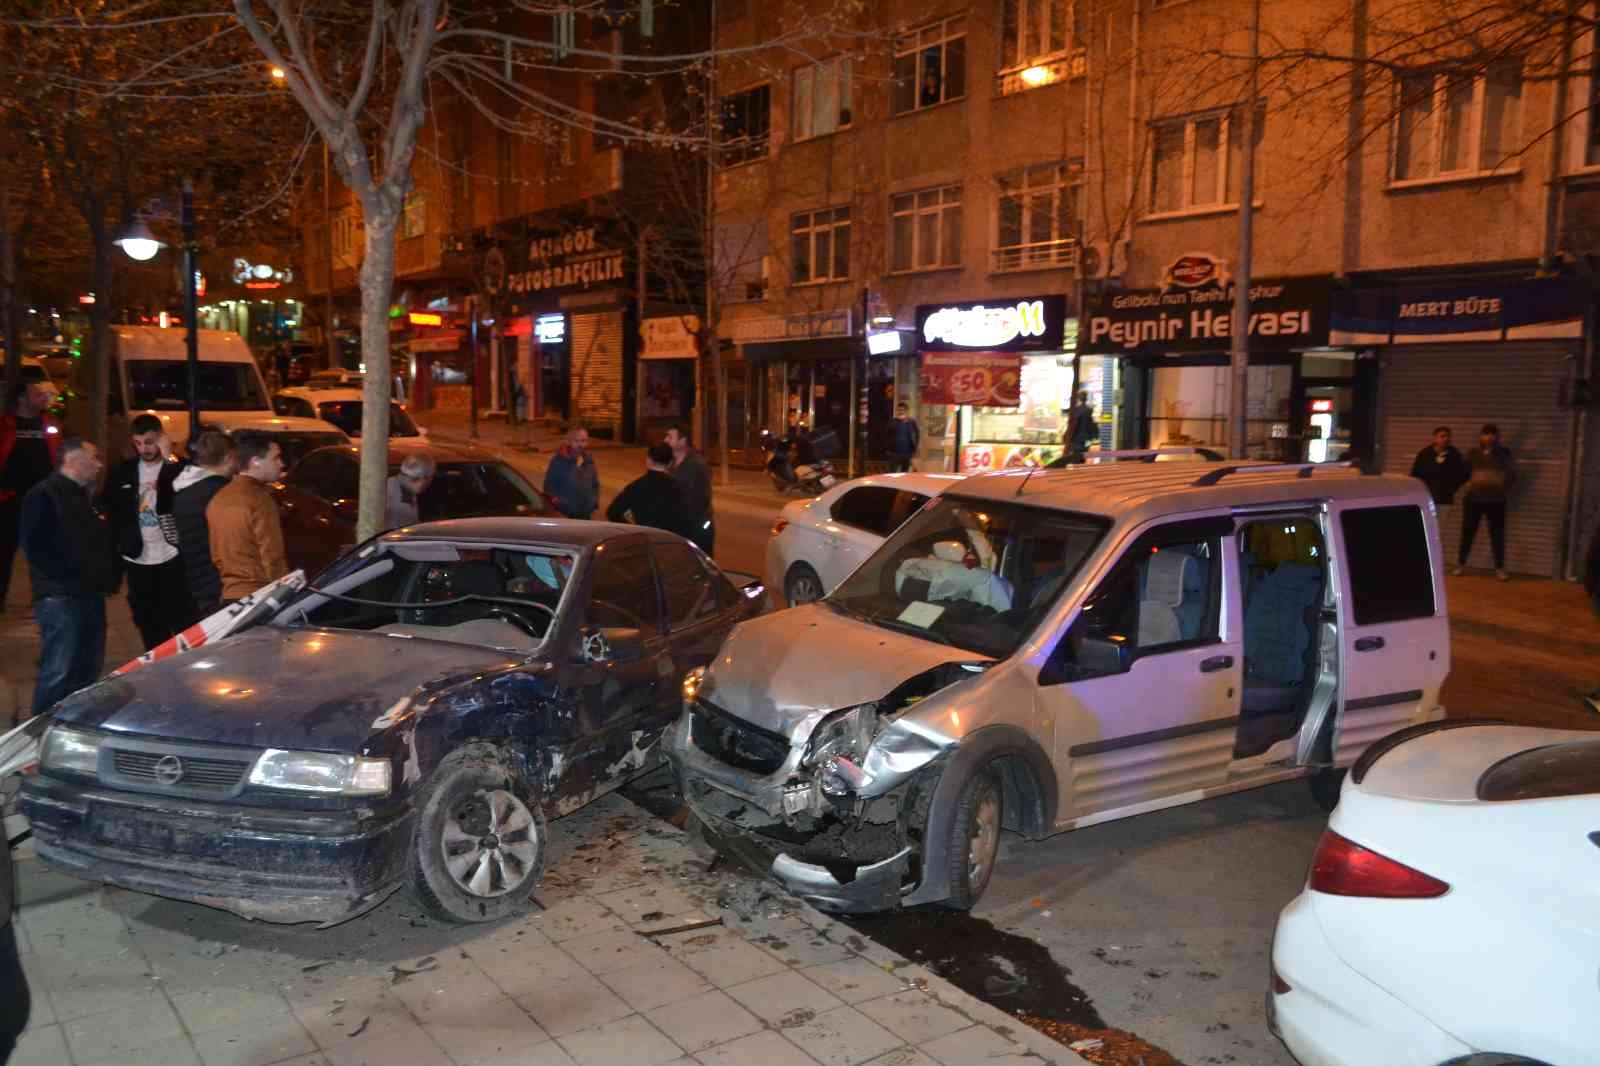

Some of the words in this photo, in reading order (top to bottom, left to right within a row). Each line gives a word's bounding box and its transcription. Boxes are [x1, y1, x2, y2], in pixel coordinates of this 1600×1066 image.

[1399, 301, 1450, 318] MERT
[1454, 296, 1501, 315] BÜFE
[1090, 313, 1183, 349] Peynir
